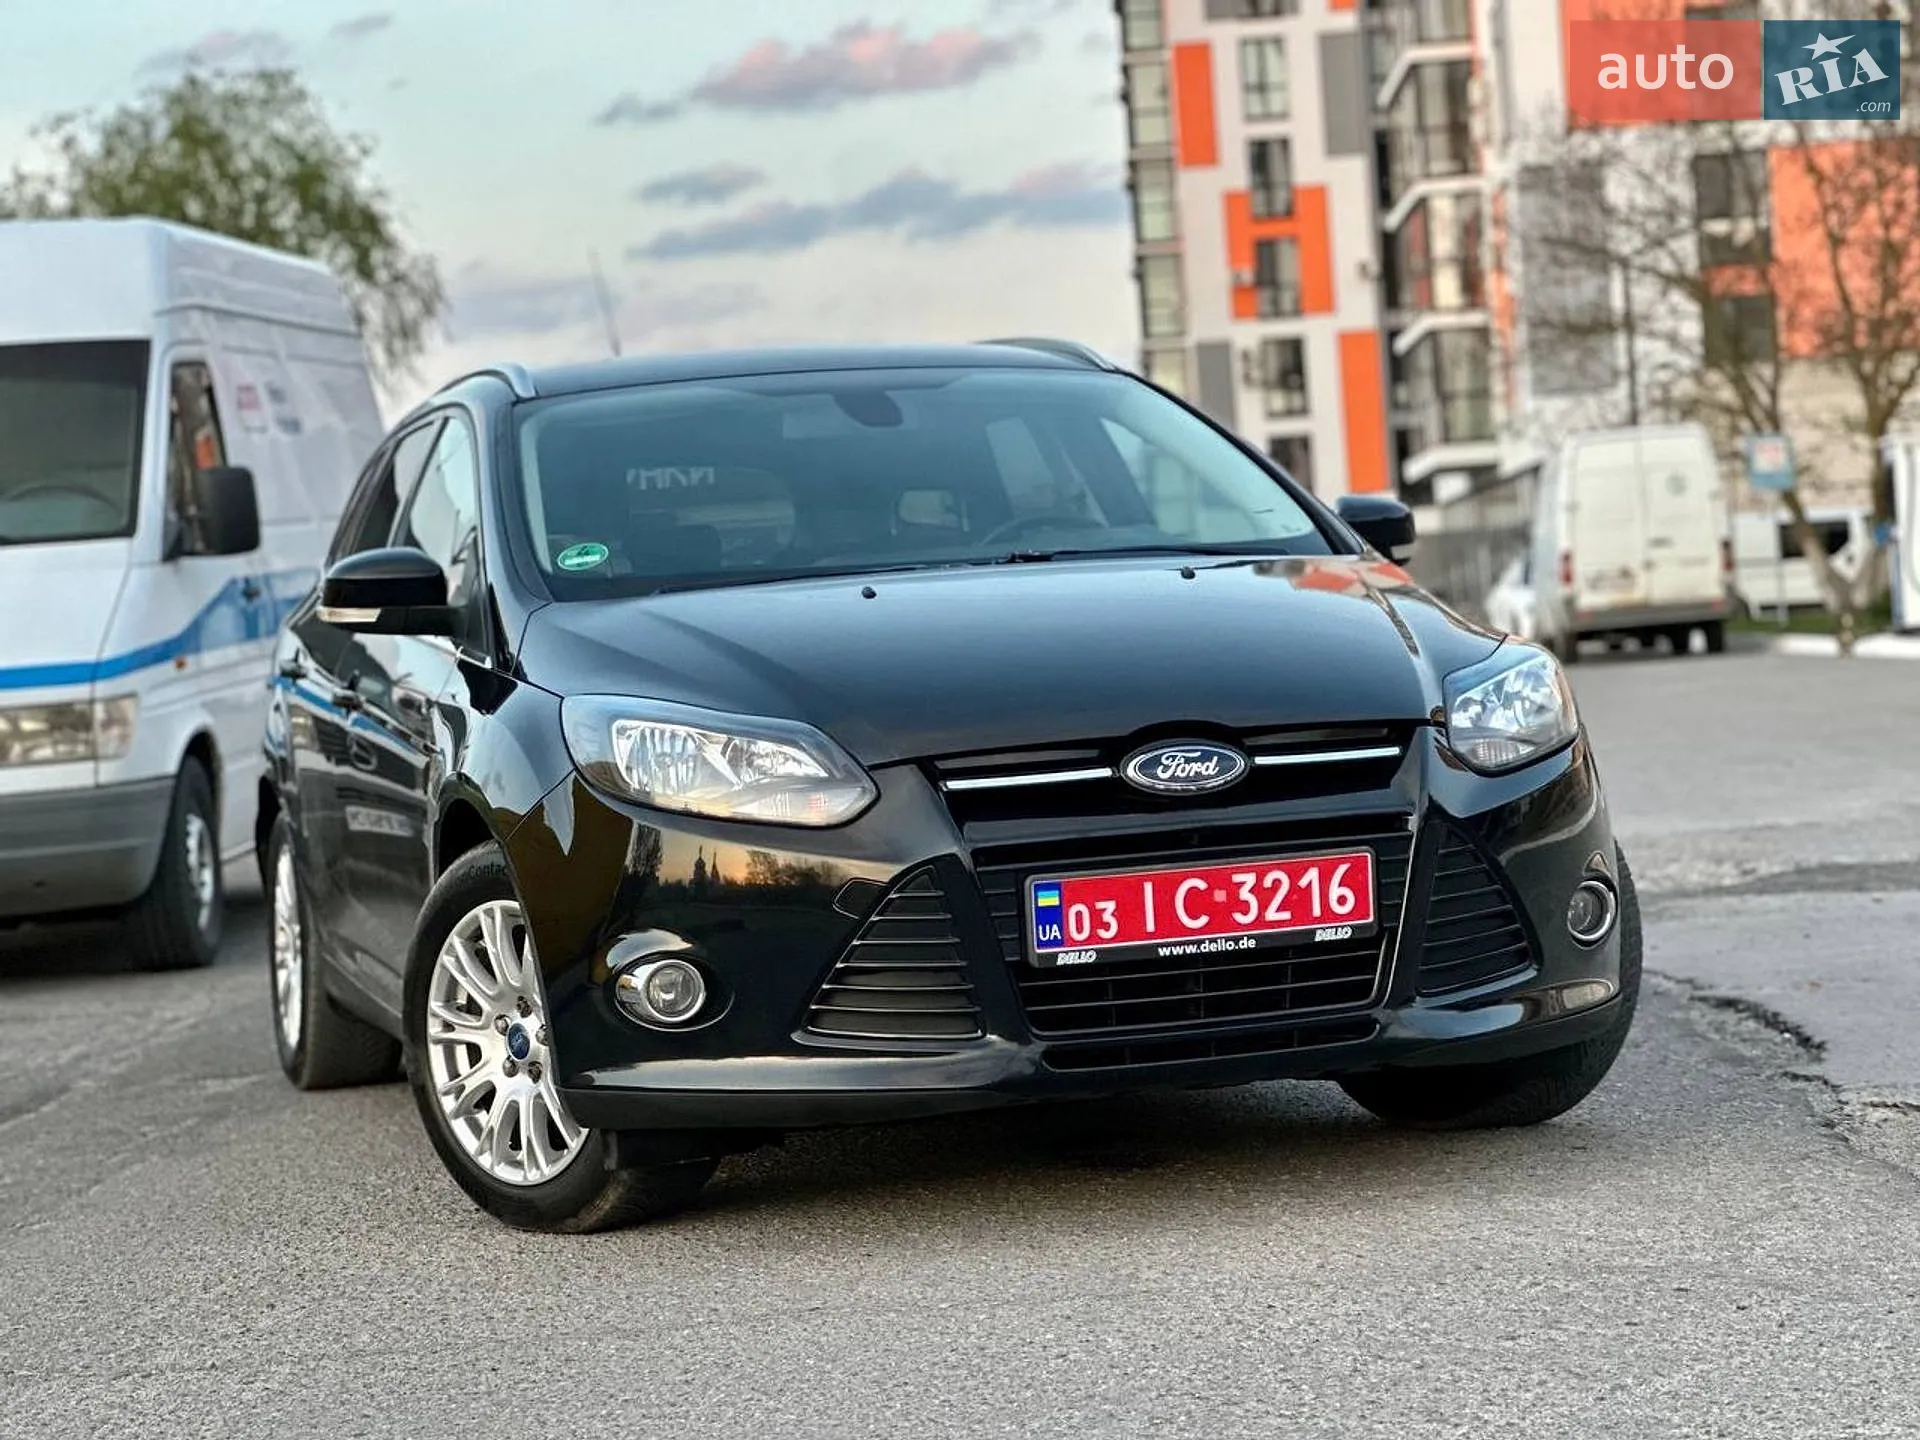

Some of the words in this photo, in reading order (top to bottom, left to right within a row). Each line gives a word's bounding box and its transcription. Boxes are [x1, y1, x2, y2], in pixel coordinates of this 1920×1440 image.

[1157, 752, 1219, 779] Ford
[1067, 900, 1119, 942] 03
[1231, 863, 1356, 925] 3216
[1038, 924, 1061, 941] UA
[1314, 926, 1353, 942] DELLO
[1158, 936, 1257, 957] www.dello.de
[1056, 950, 1098, 966] DELLO
